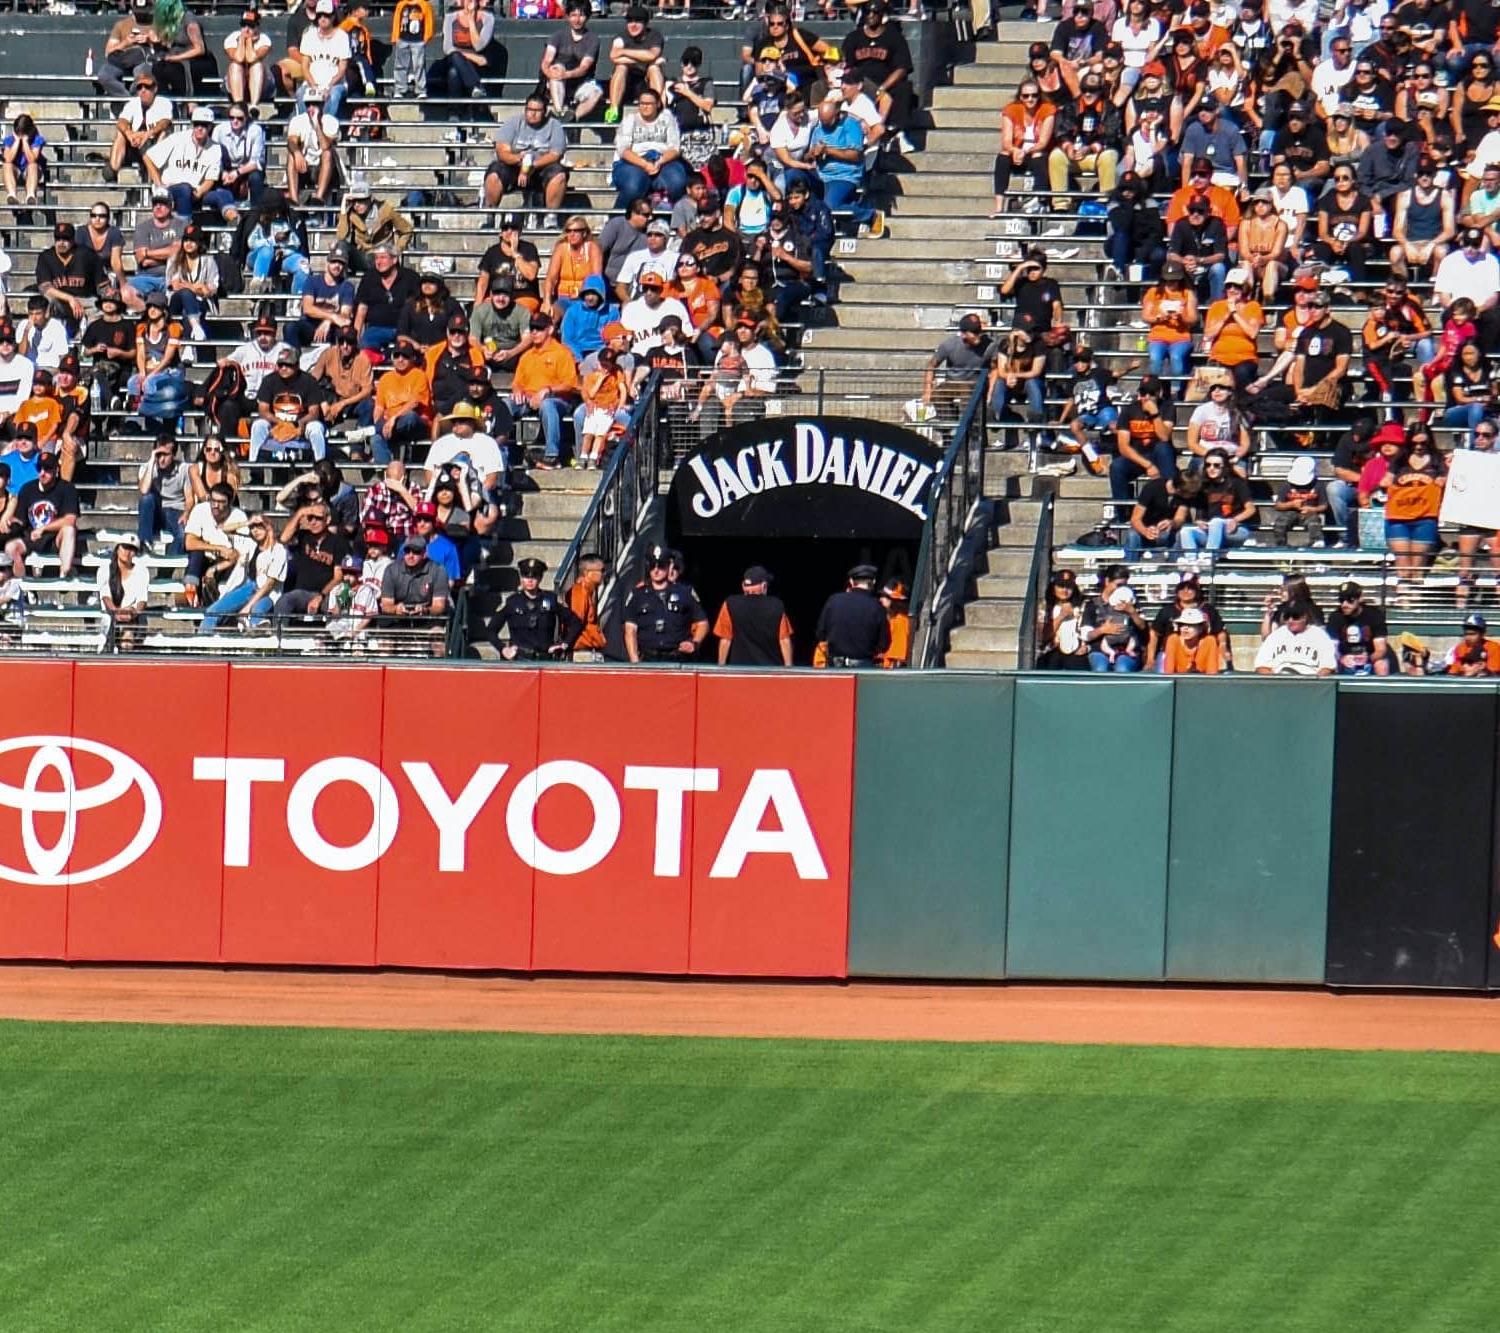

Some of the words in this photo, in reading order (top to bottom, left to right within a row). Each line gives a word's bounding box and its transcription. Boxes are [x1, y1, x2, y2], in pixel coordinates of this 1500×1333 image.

[840, 240, 855, 253] 19
[688, 440, 792, 518] JACK
[794, 422, 943, 521] DANIEL'
[193, 756, 828, 880] TOYOTA
